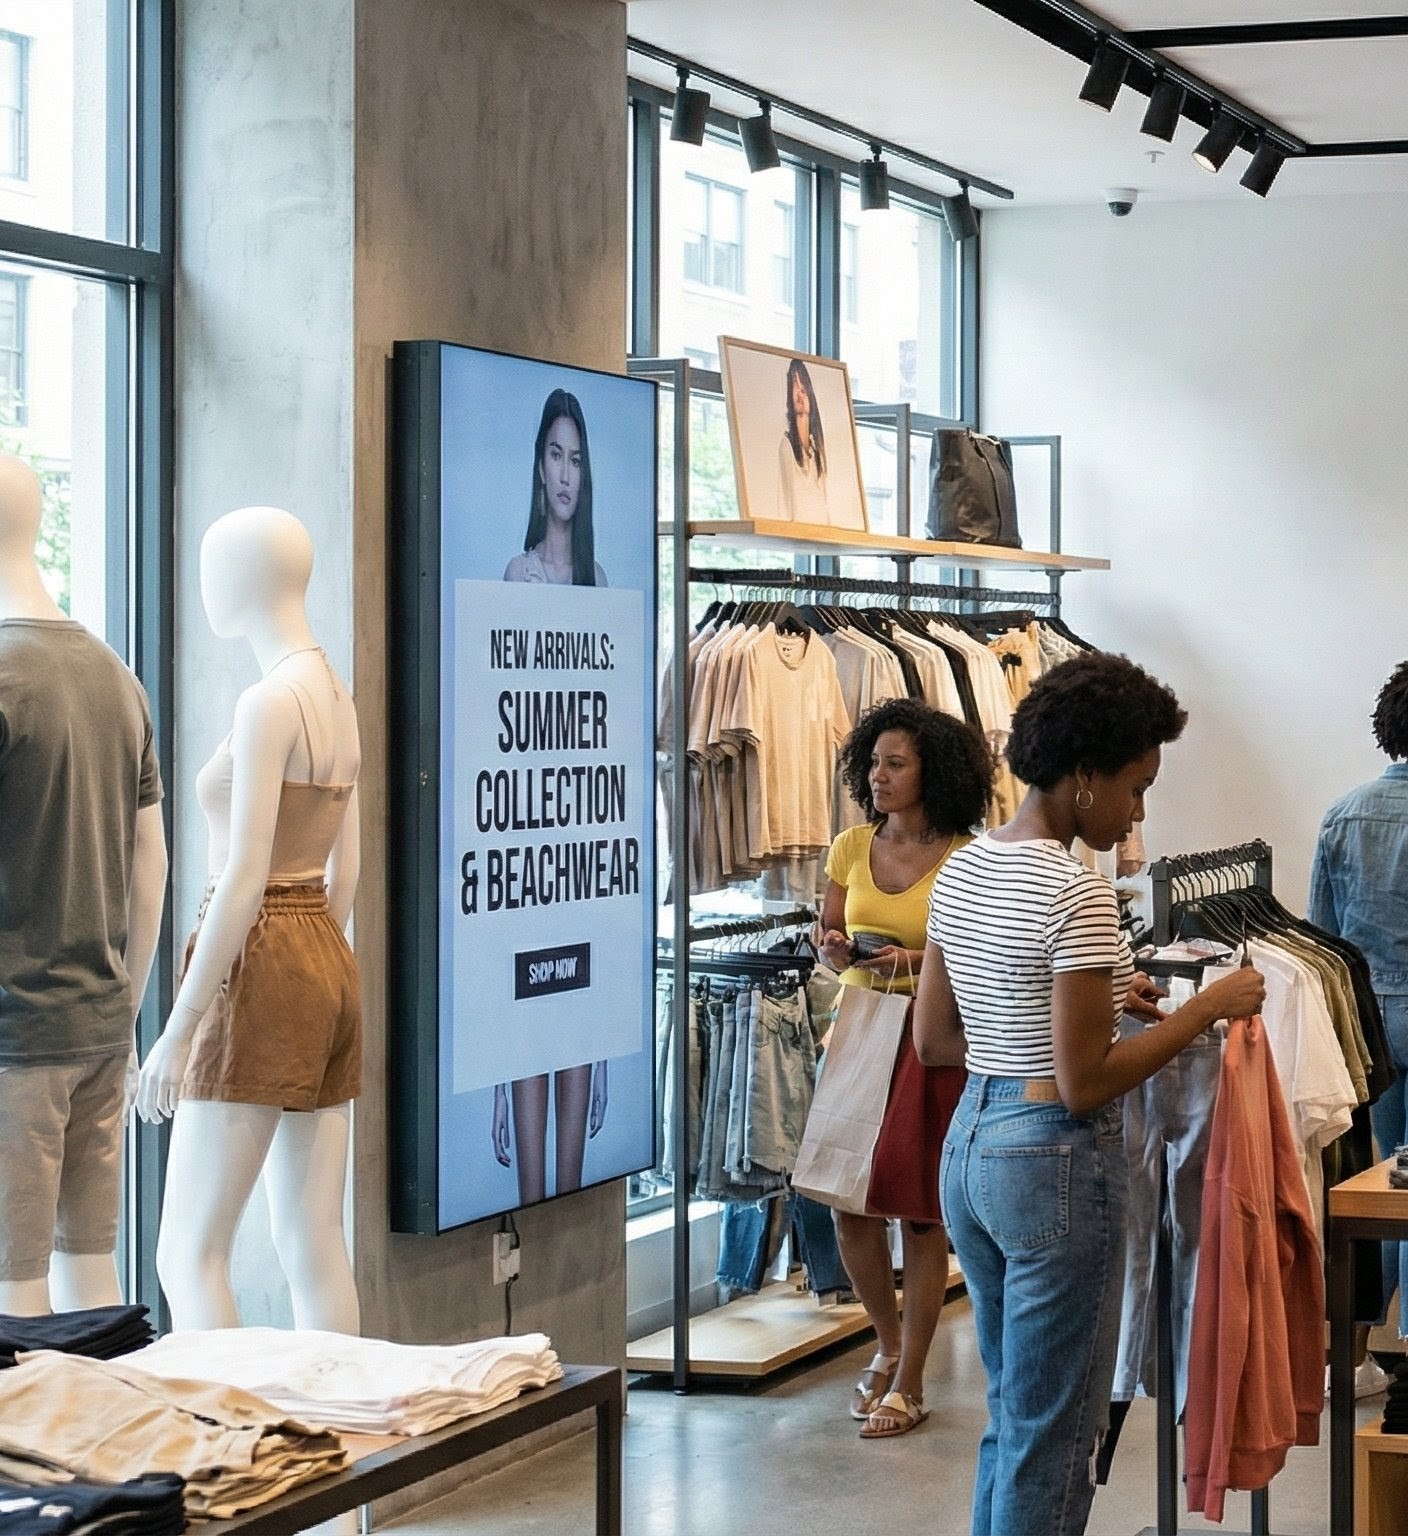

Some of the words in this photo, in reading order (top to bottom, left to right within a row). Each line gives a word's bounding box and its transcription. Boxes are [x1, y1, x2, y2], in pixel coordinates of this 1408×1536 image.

[490, 629, 529, 670] NEW
[533, 630, 615, 671] ARRIVALS:
[498, 690, 608, 754] SUMMER
[476, 764, 627, 833] COLLECTION
[461, 850, 479, 916] &
[487, 837, 639, 912] BEACHWEAR
[528, 960, 555, 985] SHOP
[555, 956, 578, 980] NOW
